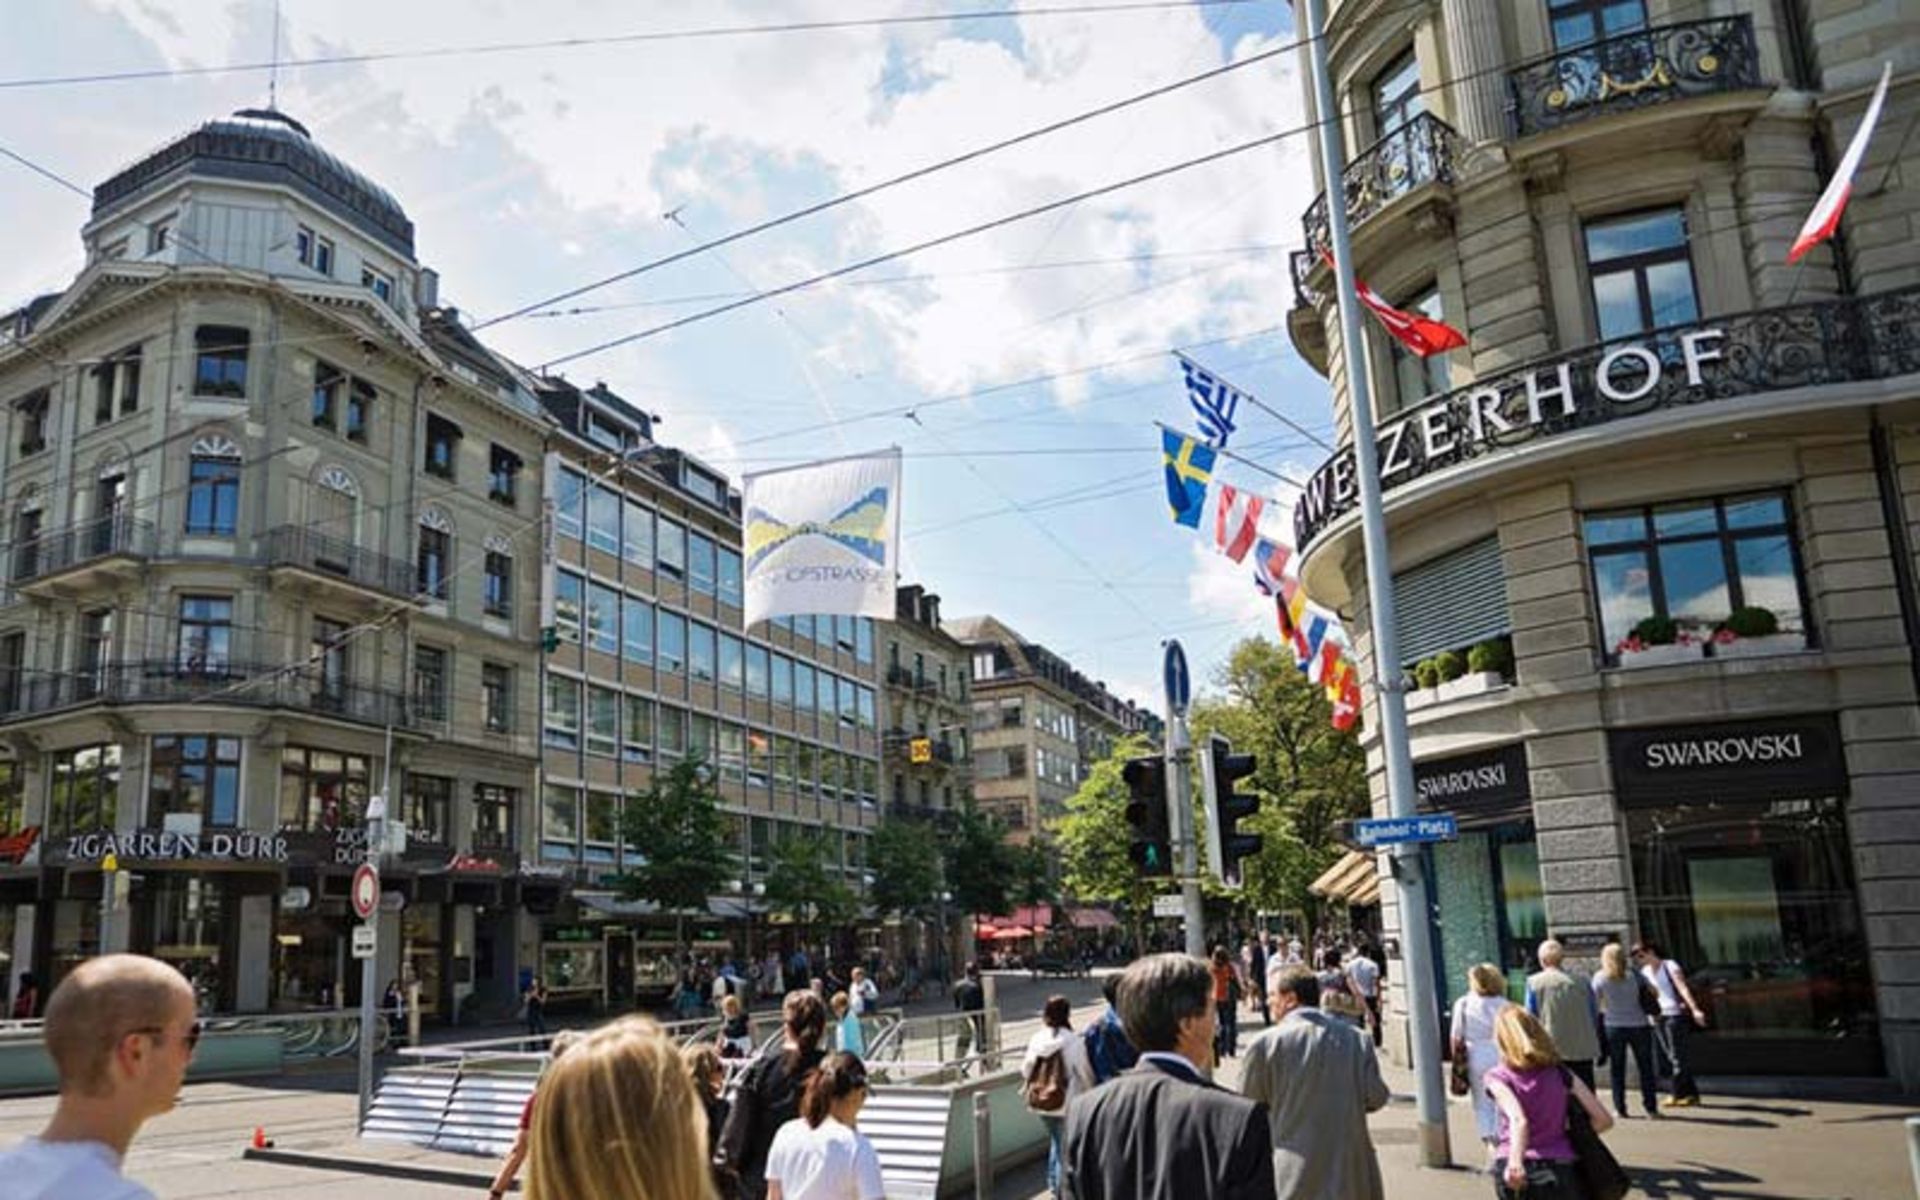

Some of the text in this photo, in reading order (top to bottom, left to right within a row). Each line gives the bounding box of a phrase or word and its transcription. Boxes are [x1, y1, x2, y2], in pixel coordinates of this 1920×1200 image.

[1647, 733, 1802, 767] SWAROVSKI
[1418, 762, 1505, 799] SWAROVSKI
[67, 834, 198, 859] ZIGARREN
[212, 832, 289, 863] DÜRR
